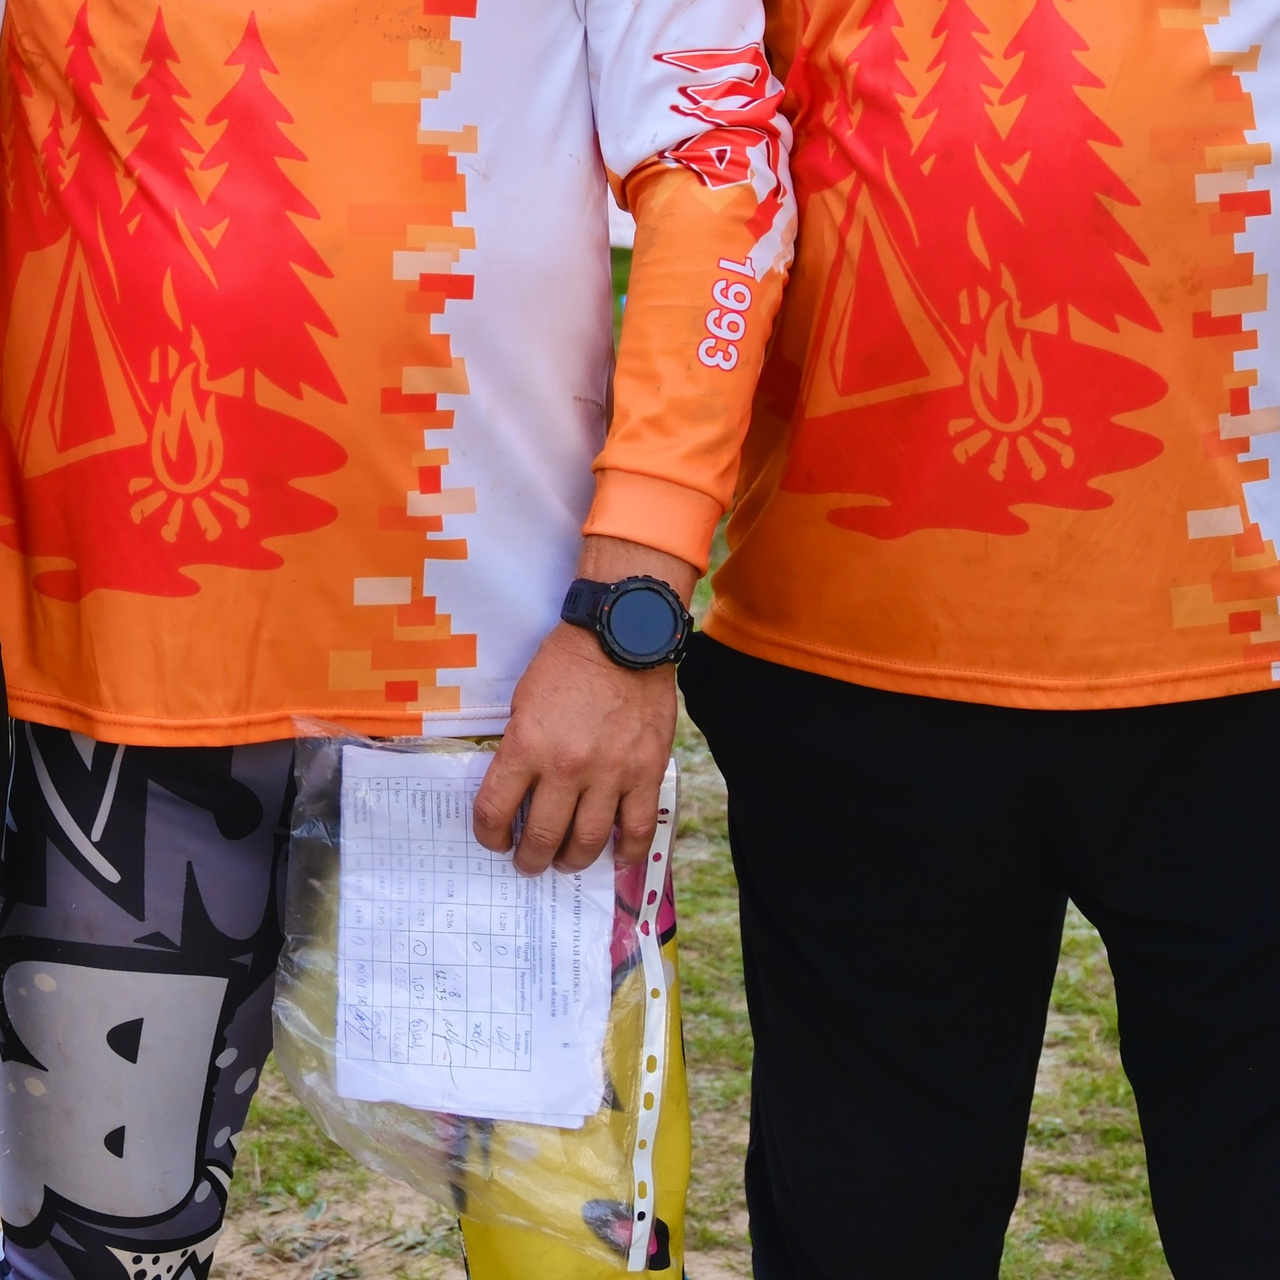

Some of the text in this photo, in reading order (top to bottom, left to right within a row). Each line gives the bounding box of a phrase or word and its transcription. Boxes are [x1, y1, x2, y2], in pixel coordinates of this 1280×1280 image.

[696, 255, 758, 372] 1993
[500, 882, 508, 901] 12:17
[446, 908, 454, 929] 12:36
[499, 911, 508, 932] 12:20
